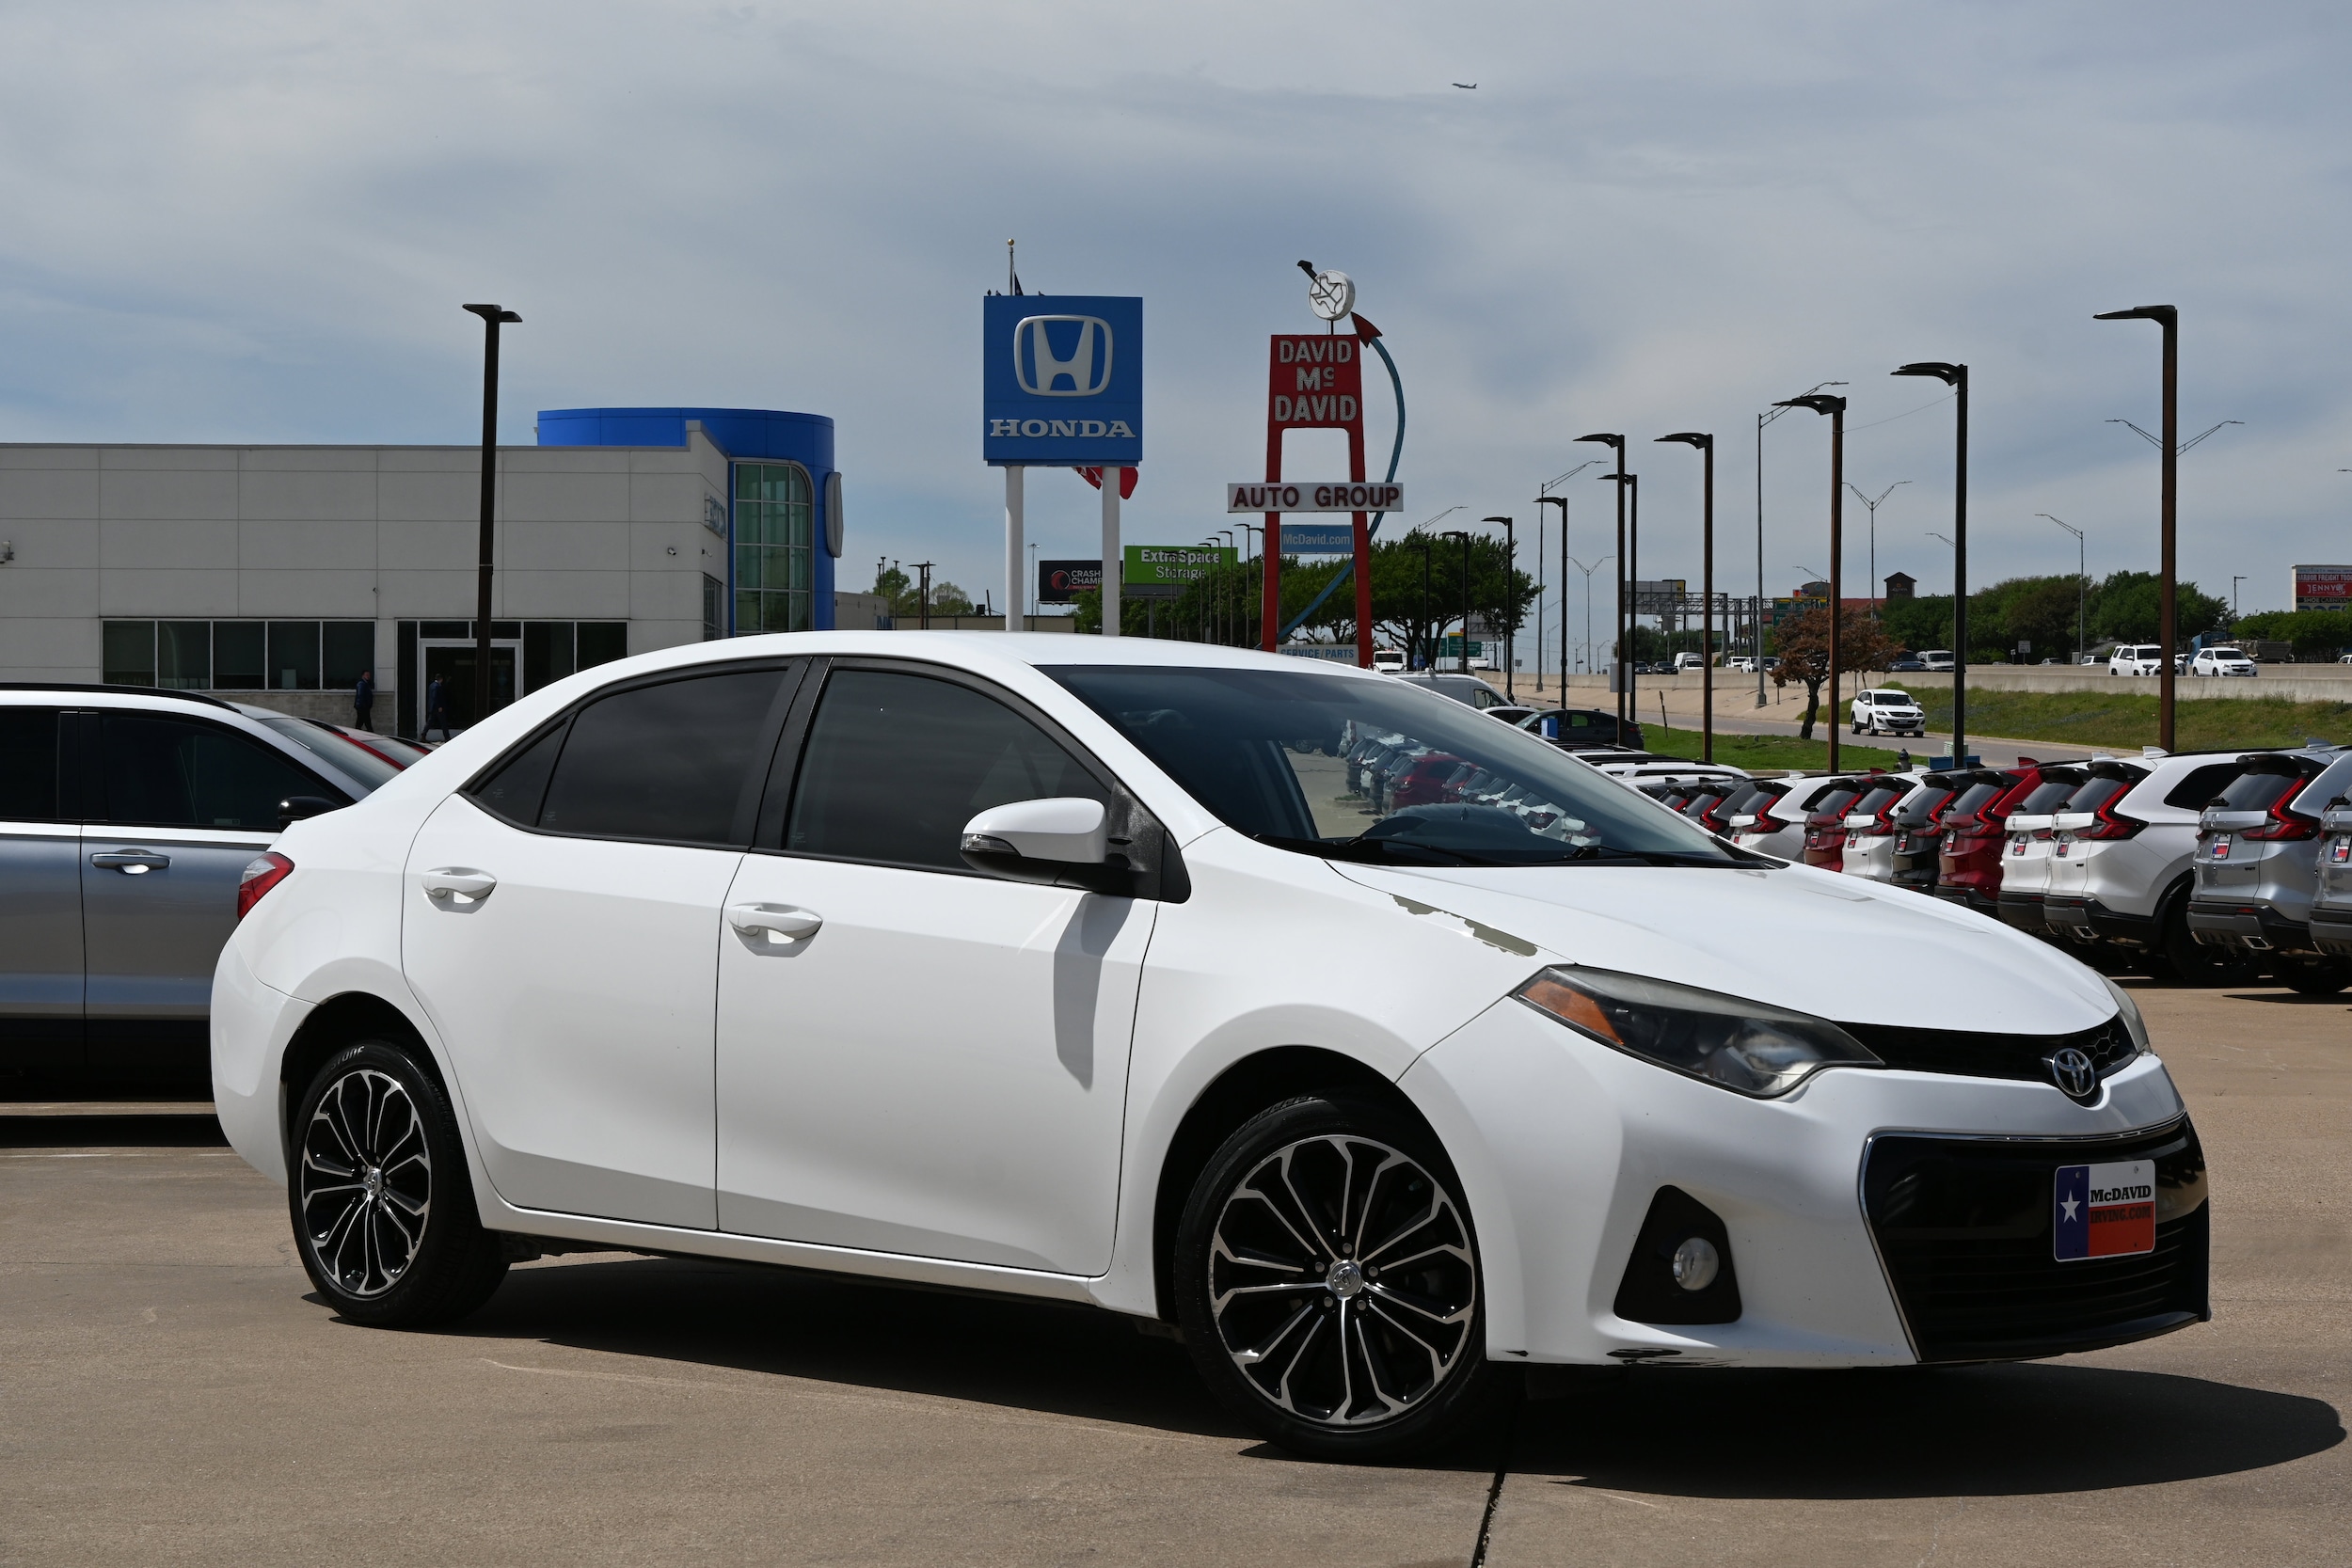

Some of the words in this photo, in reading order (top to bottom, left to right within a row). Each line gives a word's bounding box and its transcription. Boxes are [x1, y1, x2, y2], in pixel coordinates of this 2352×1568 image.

[1279, 340, 1352, 363] DAVID
[1296, 366, 1334, 391] Mc
[1274, 395, 1357, 421] DAVID
[990, 419, 1136, 438] HONDA
[1232, 486, 1300, 508] AUTO
[1314, 486, 1400, 508] GROUP
[1282, 533, 1351, 546] McDavid.com
[1141, 549, 1177, 562] Extra
[1178, 549, 1221, 565] Space
[1071, 569, 1101, 578] CRASH
[1155, 565, 1206, 580] Storage
[2307, 584, 2336, 594] JENNY
[2090, 1184, 2152, 1203] McDAVID
[2090, 1205, 2152, 1224] IRVING.COM
